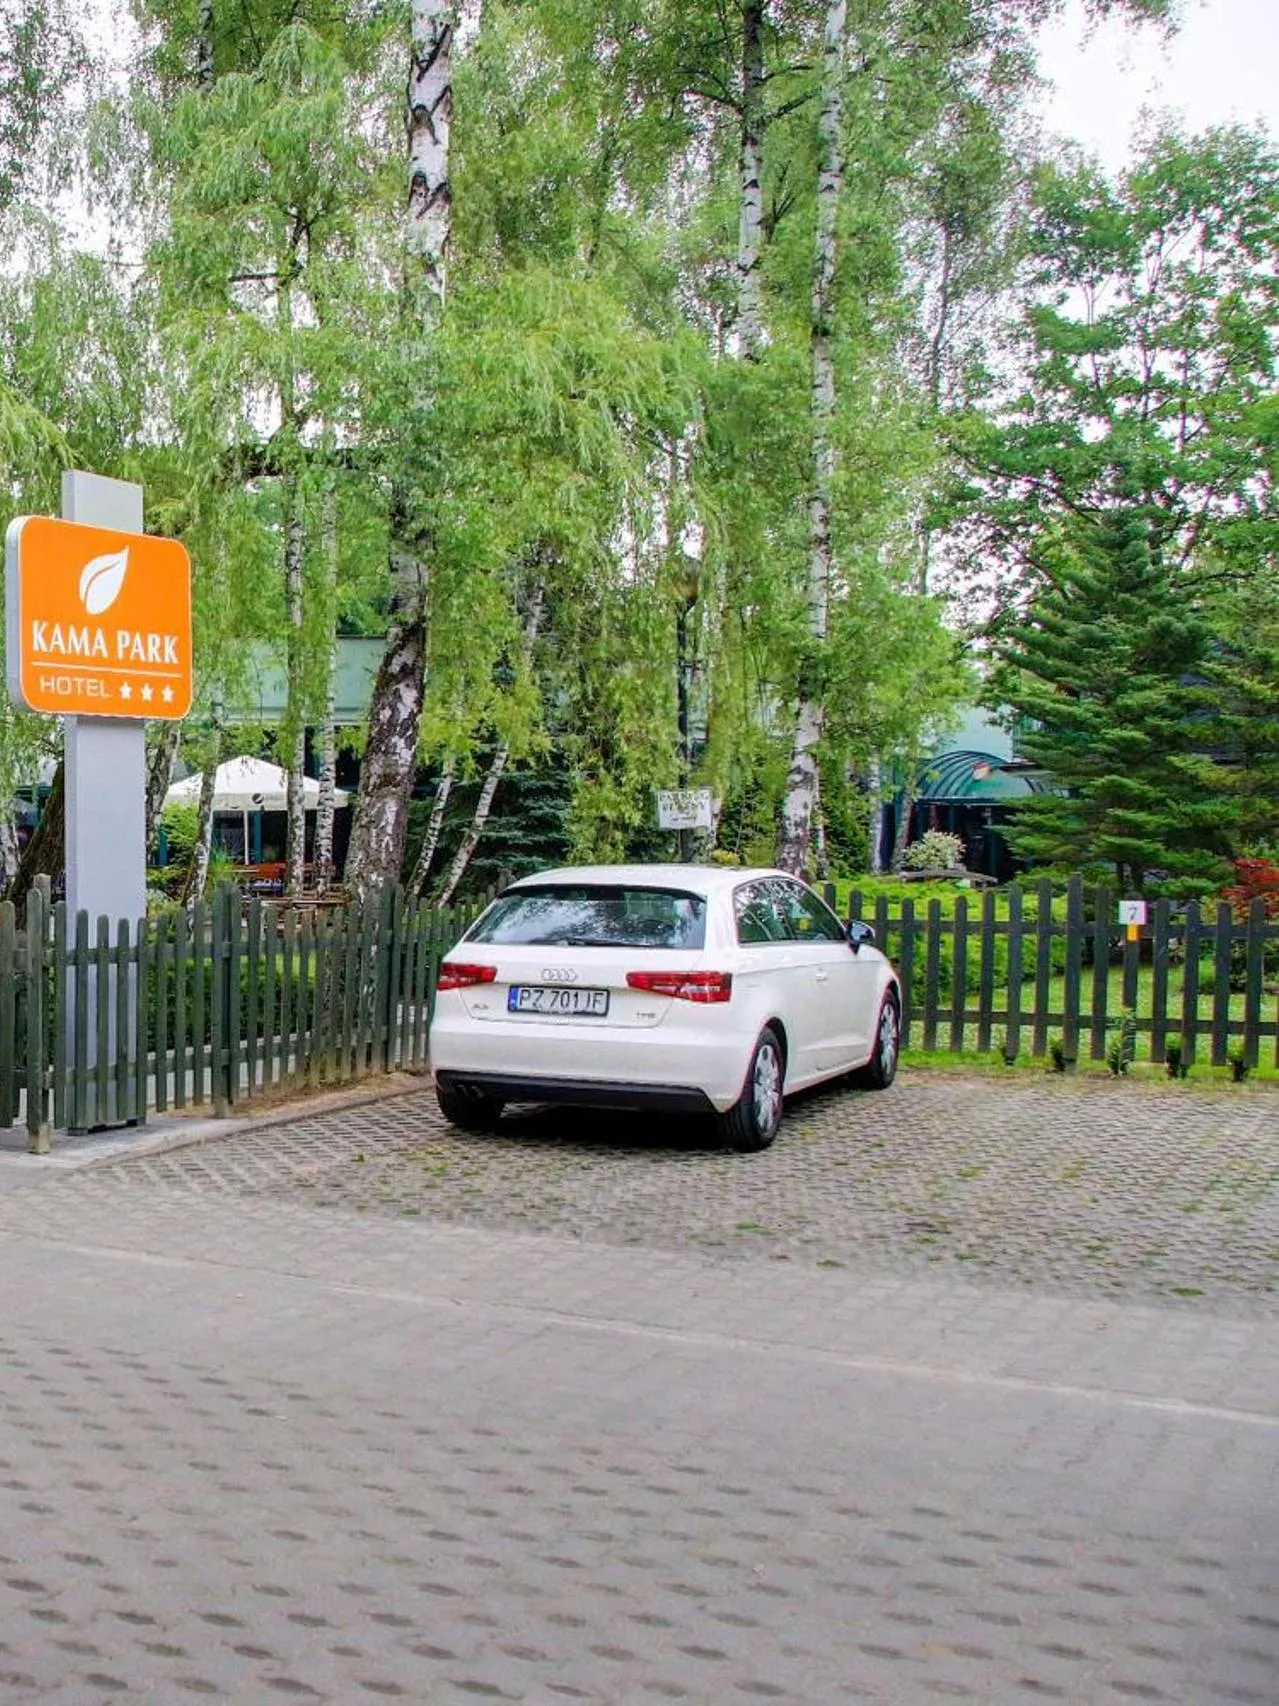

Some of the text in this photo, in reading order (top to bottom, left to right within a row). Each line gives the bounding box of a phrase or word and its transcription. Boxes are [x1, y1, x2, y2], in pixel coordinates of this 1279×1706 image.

[32, 619, 179, 664] KAMA PARK
[39, 674, 113, 697] HOTEL
[1128, 906, 1137, 919] 7
[520, 989, 544, 1008] PZ
